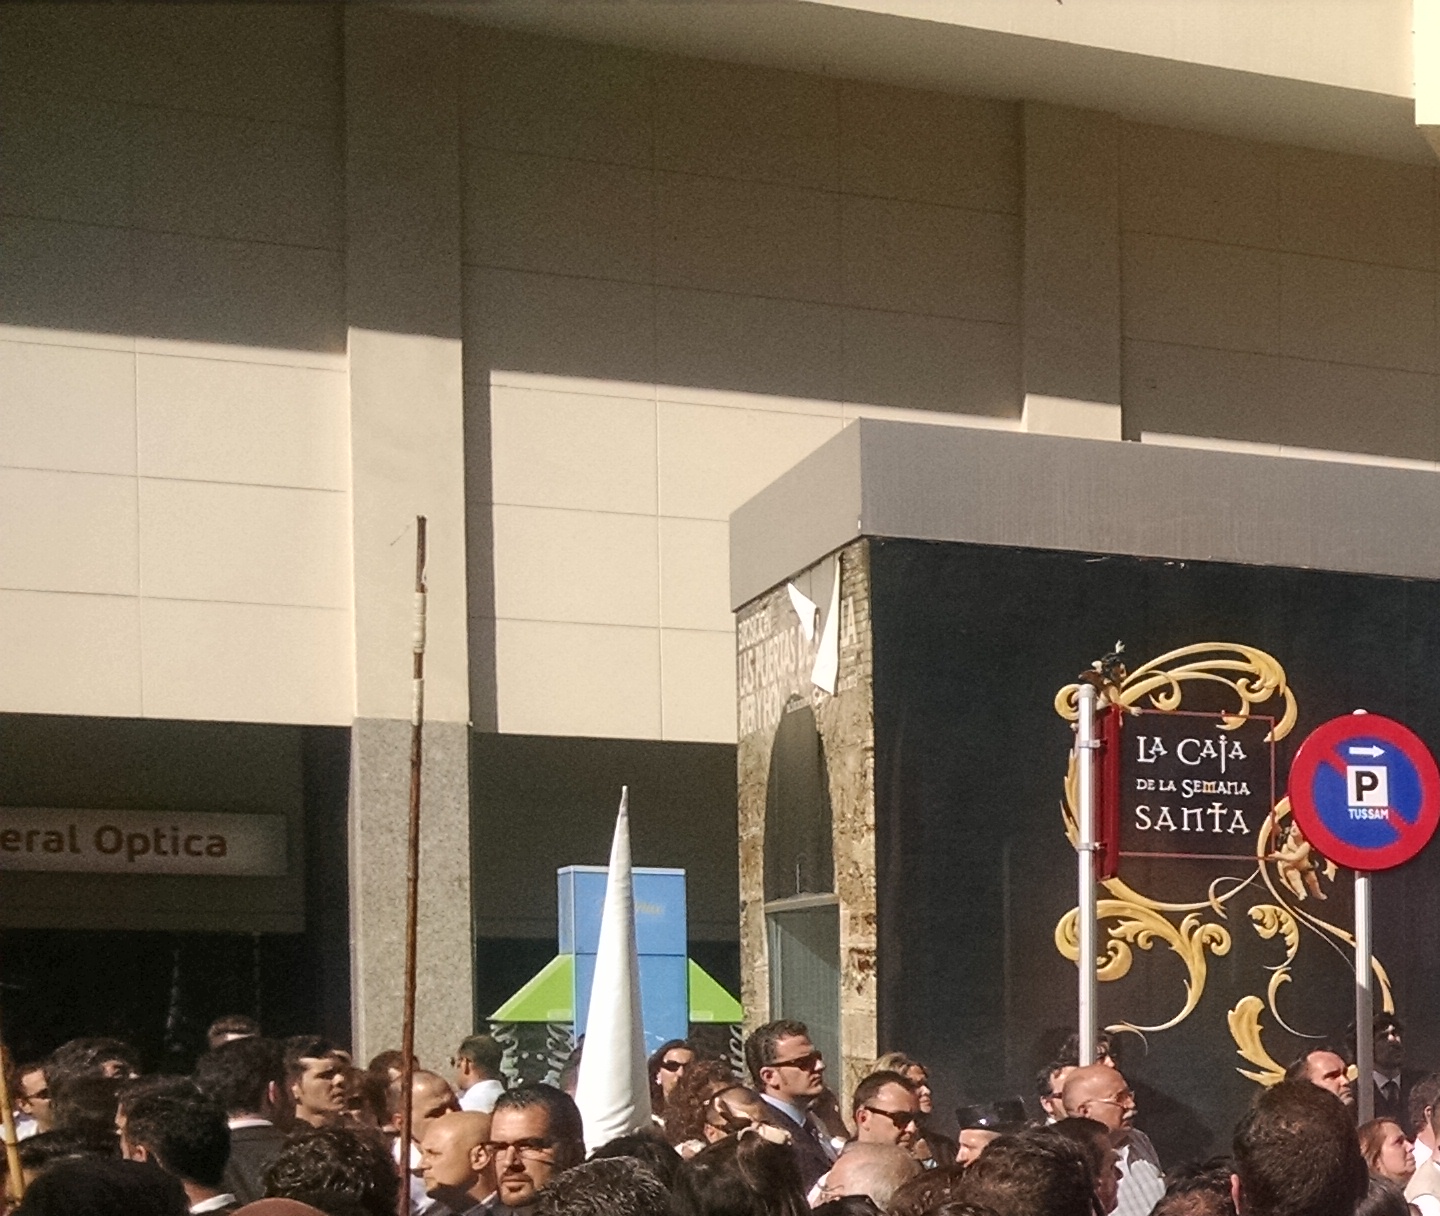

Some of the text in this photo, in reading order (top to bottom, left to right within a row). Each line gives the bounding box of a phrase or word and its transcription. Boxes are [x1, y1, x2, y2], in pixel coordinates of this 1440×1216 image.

[1136, 736, 1168, 763] LA
[1136, 779, 1251, 798] DE LA SEMANA
[1355, 771, 1379, 802] P
[1135, 802, 1251, 835] SANTA
[1348, 808, 1389, 820] TUSSAM
[94, 824, 229, 863] Optica
